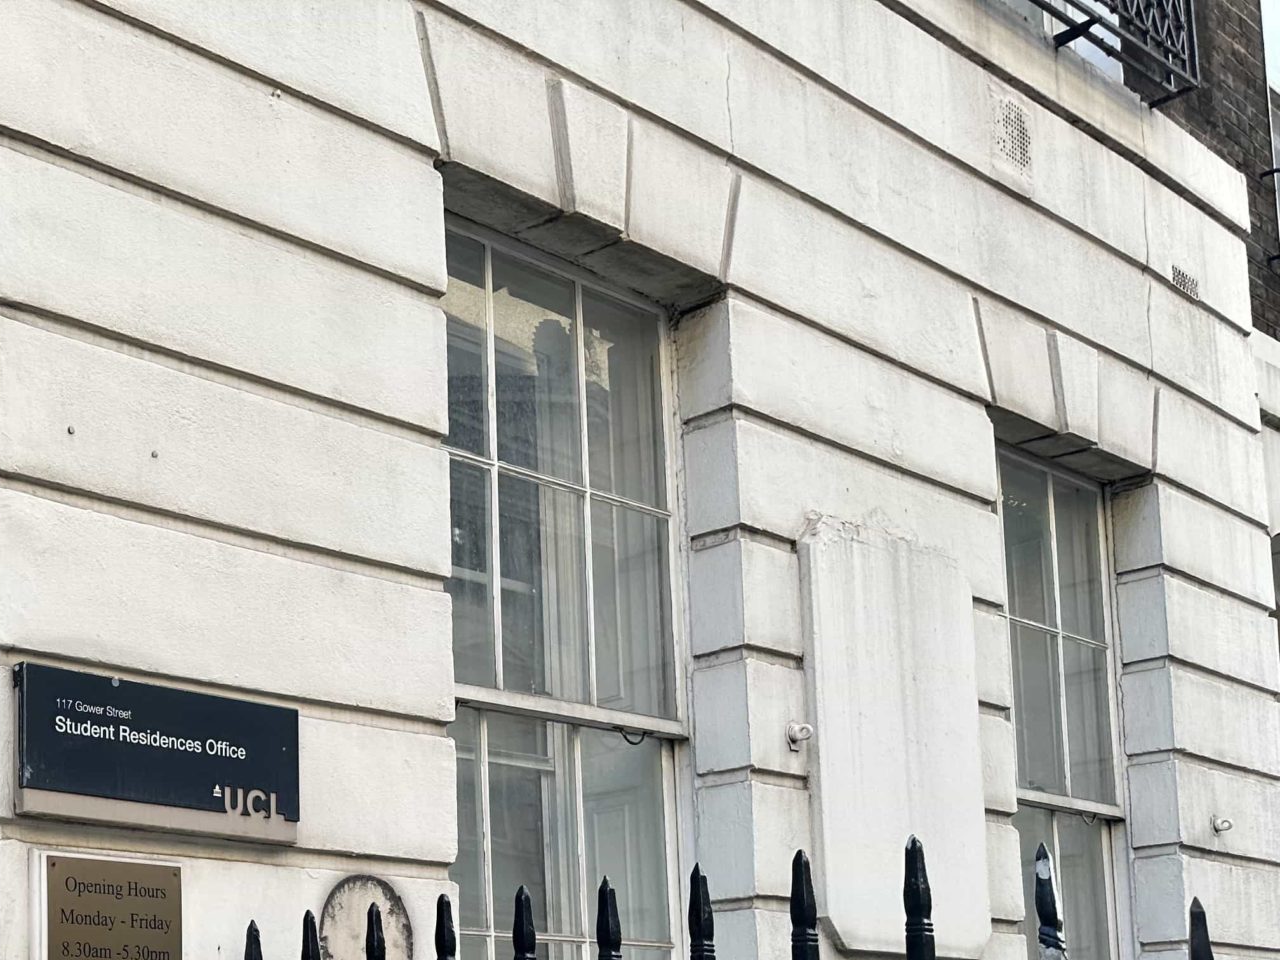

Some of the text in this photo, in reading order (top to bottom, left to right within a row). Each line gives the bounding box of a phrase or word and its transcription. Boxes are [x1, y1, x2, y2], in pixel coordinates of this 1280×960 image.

[56, 698, 132, 719] 117 Gower Street
[55, 716, 246, 759] Student Residences Office
[224, 786, 285, 818] UCL
[65, 876, 167, 900] Opening Hours
[60, 908, 116, 931] Monday
[130, 913, 172, 934] Friday
[62, 940, 112, 959] 8.30am
